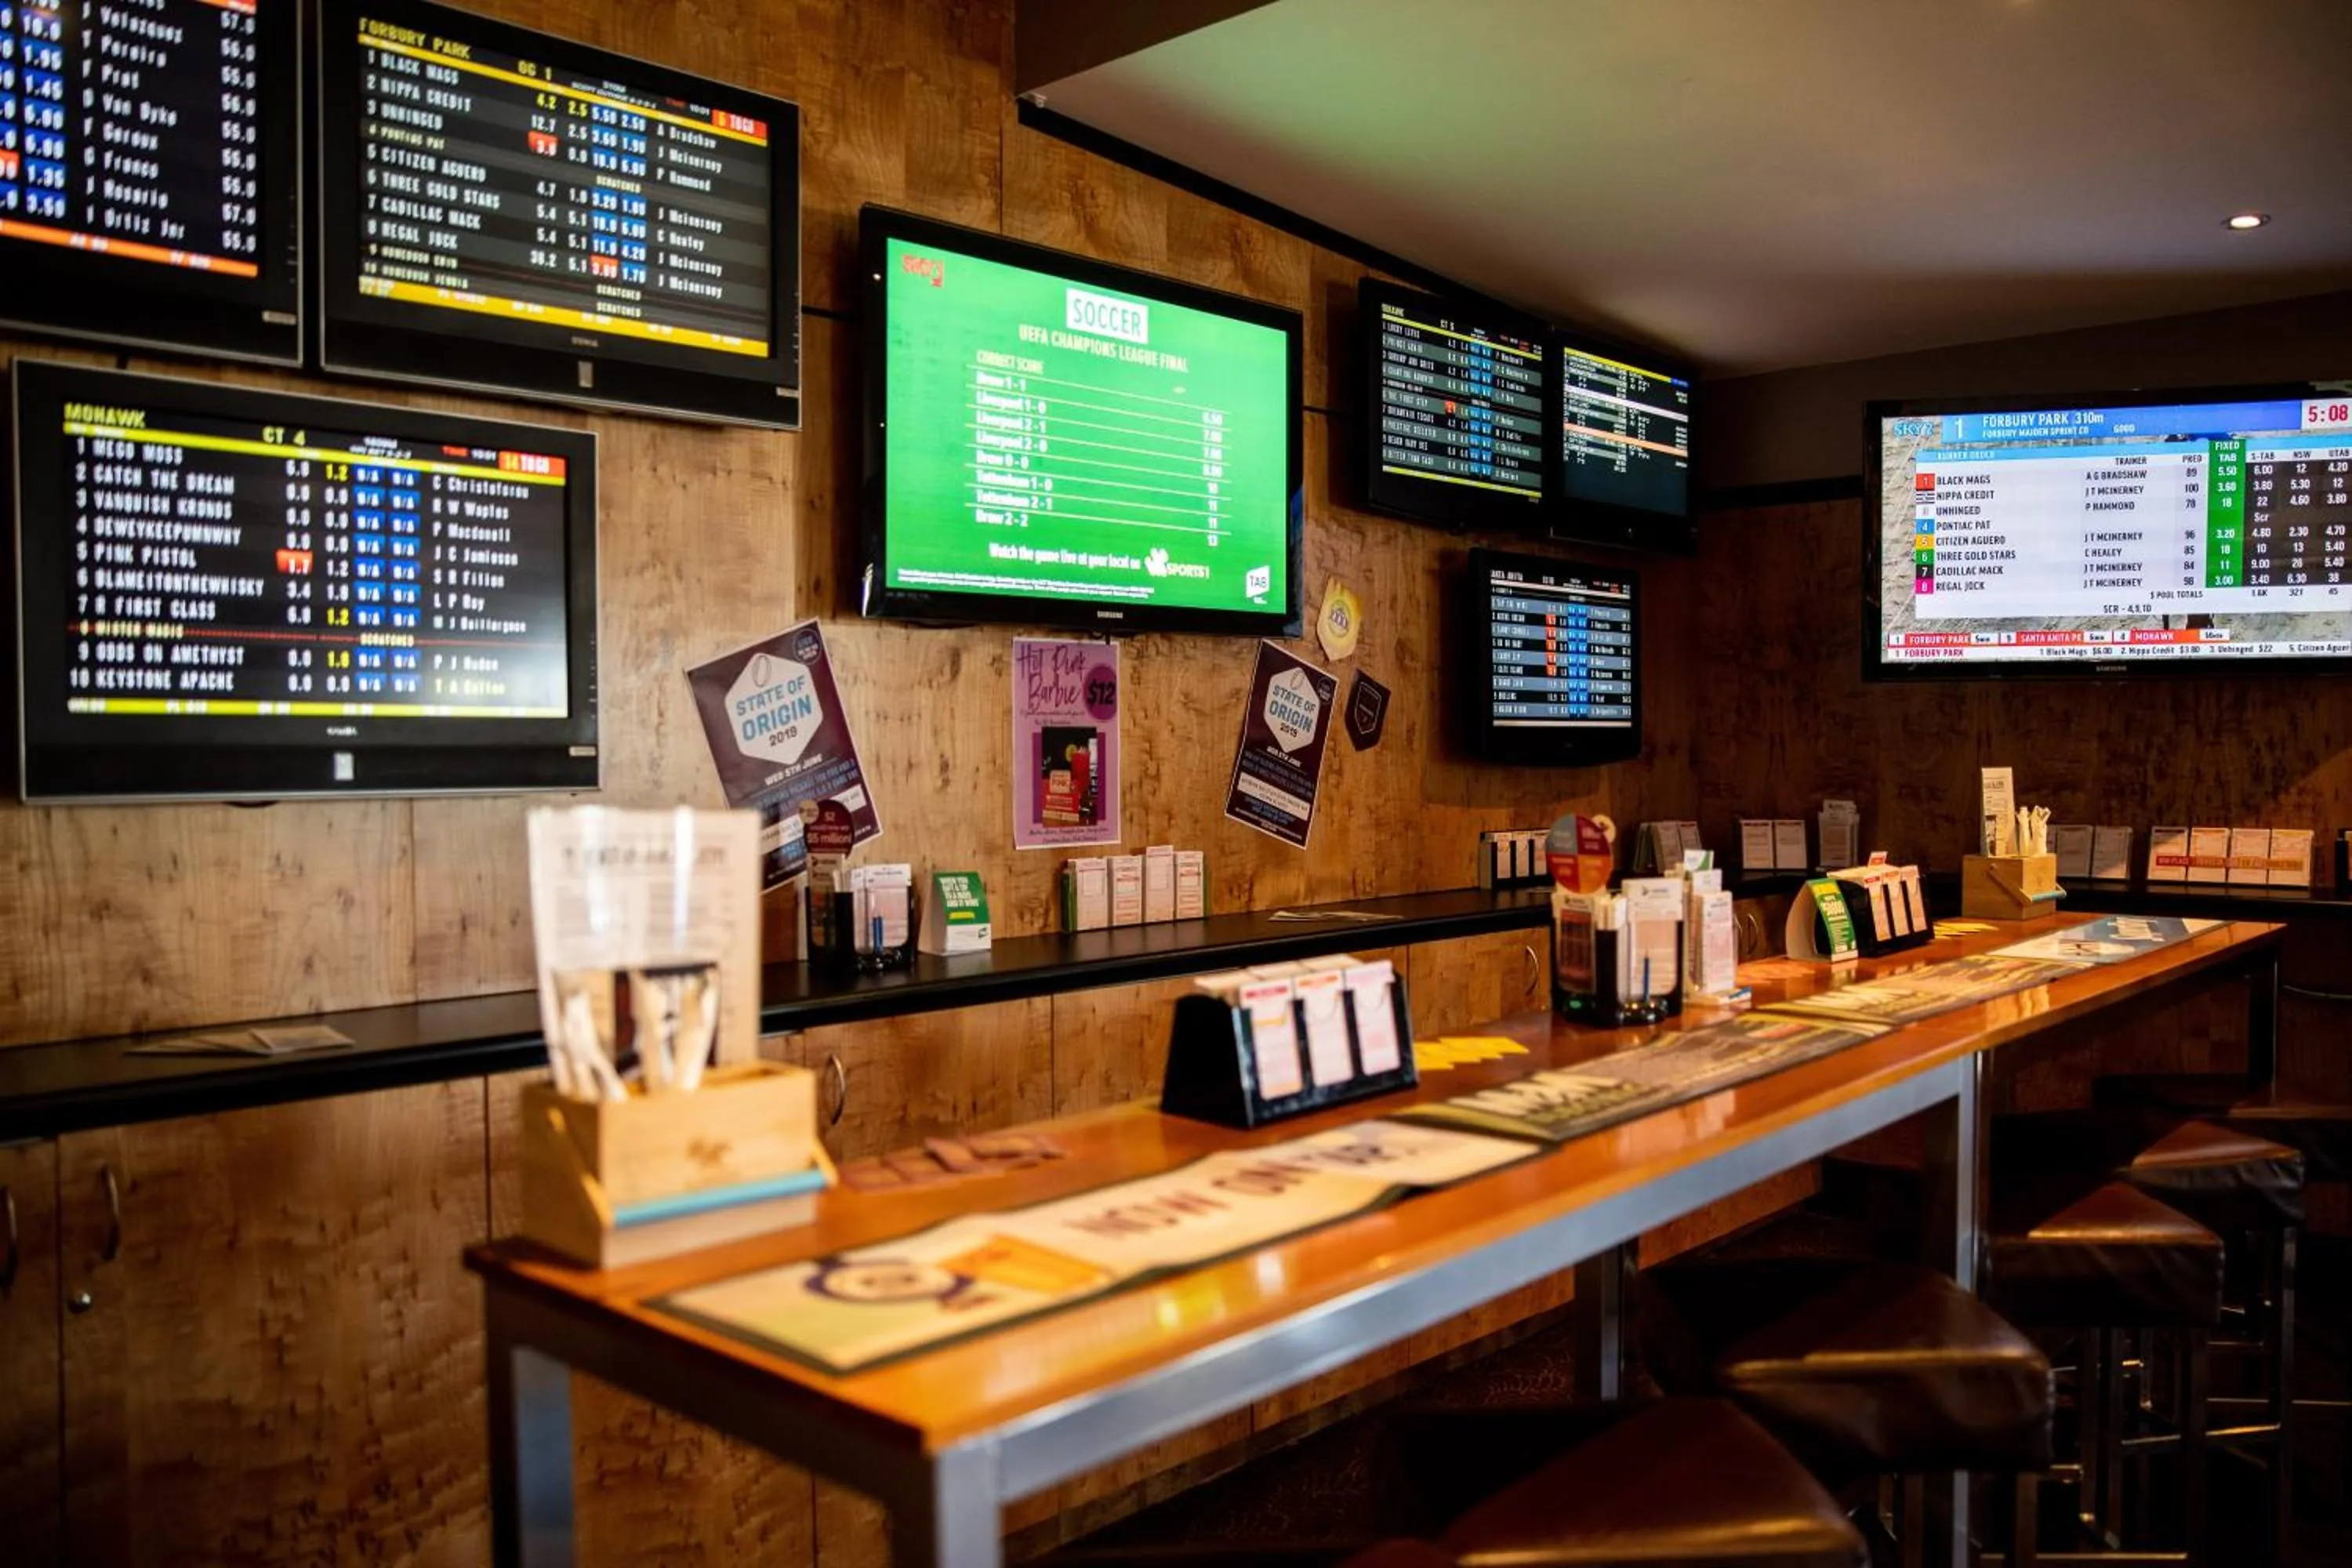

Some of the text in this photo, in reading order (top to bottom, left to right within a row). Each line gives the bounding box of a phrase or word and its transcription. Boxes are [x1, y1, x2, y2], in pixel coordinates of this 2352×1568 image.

[358, 16, 473, 59] FORBURY PARK
[366, 74, 376, 90] 2
[535, 93, 557, 110] 4.2
[531, 114, 557, 132] 12.7
[367, 194, 376, 210] 7
[1072, 297, 1142, 337] SOCCER
[1018, 323, 1189, 374] UEFA CHAMPIONS LEAGUE FINAL
[64, 401, 147, 429] MOHAWK
[1982, 411, 2104, 428] FORBURY PARK 310m
[2307, 405, 2349, 423] 5:08
[263, 426, 307, 445] CT 4
[1954, 418, 1964, 440] 1
[1982, 428, 2018, 439] FORBURY
[2215, 441, 2240, 452] FIXED
[76, 461, 87, 482] 2
[325, 463, 348, 482] 1.2
[2296, 463, 2307, 474] 12
[1936, 475, 1964, 485] BLACK
[2333, 478, 2343, 488] 12
[1936, 490, 1994, 500] NIPPA CREDIT
[76, 515, 88, 535] 4
[1936, 520, 1991, 531] PONTIAC PAT
[2254, 512, 2270, 522] Scr
[1936, 536, 1969, 546] CITIZEN
[1936, 552, 1962, 562] THREE
[1965, 550, 1987, 561] GOLD
[1989, 550, 2016, 560] STARS
[1921, 565, 2004, 578] 7 CADILLAC MACK
[1249, 575, 1267, 588] TAB
[78, 593, 89, 615] 7
[735, 675, 806, 716] STATE OF
[1028, 672, 1081, 710] Barbie
[1087, 679, 1116, 707] $12
[1272, 684, 1303, 706] STATE
[1304, 699, 1316, 713] OF
[742, 694, 812, 742] ORIGIN
[1269, 699, 1313, 734] ORIGIN
[768, 726, 798, 747] 2019
